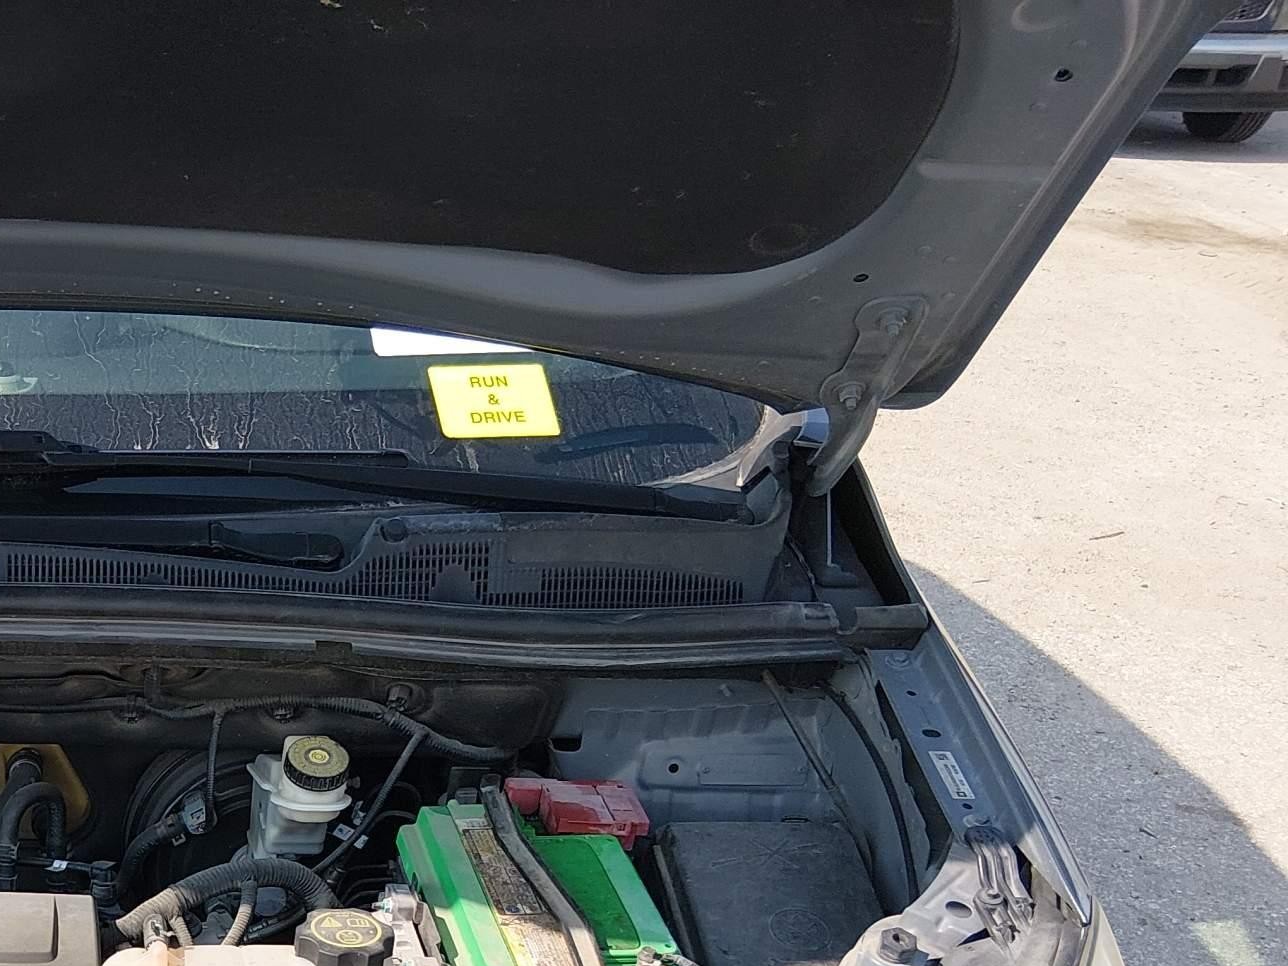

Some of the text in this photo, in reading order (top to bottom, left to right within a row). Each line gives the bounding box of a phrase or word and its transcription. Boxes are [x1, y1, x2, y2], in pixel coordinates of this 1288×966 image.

[469, 376, 508, 388] RUN
[488, 394, 500, 405] &
[470, 411, 526, 424] DRIVE
